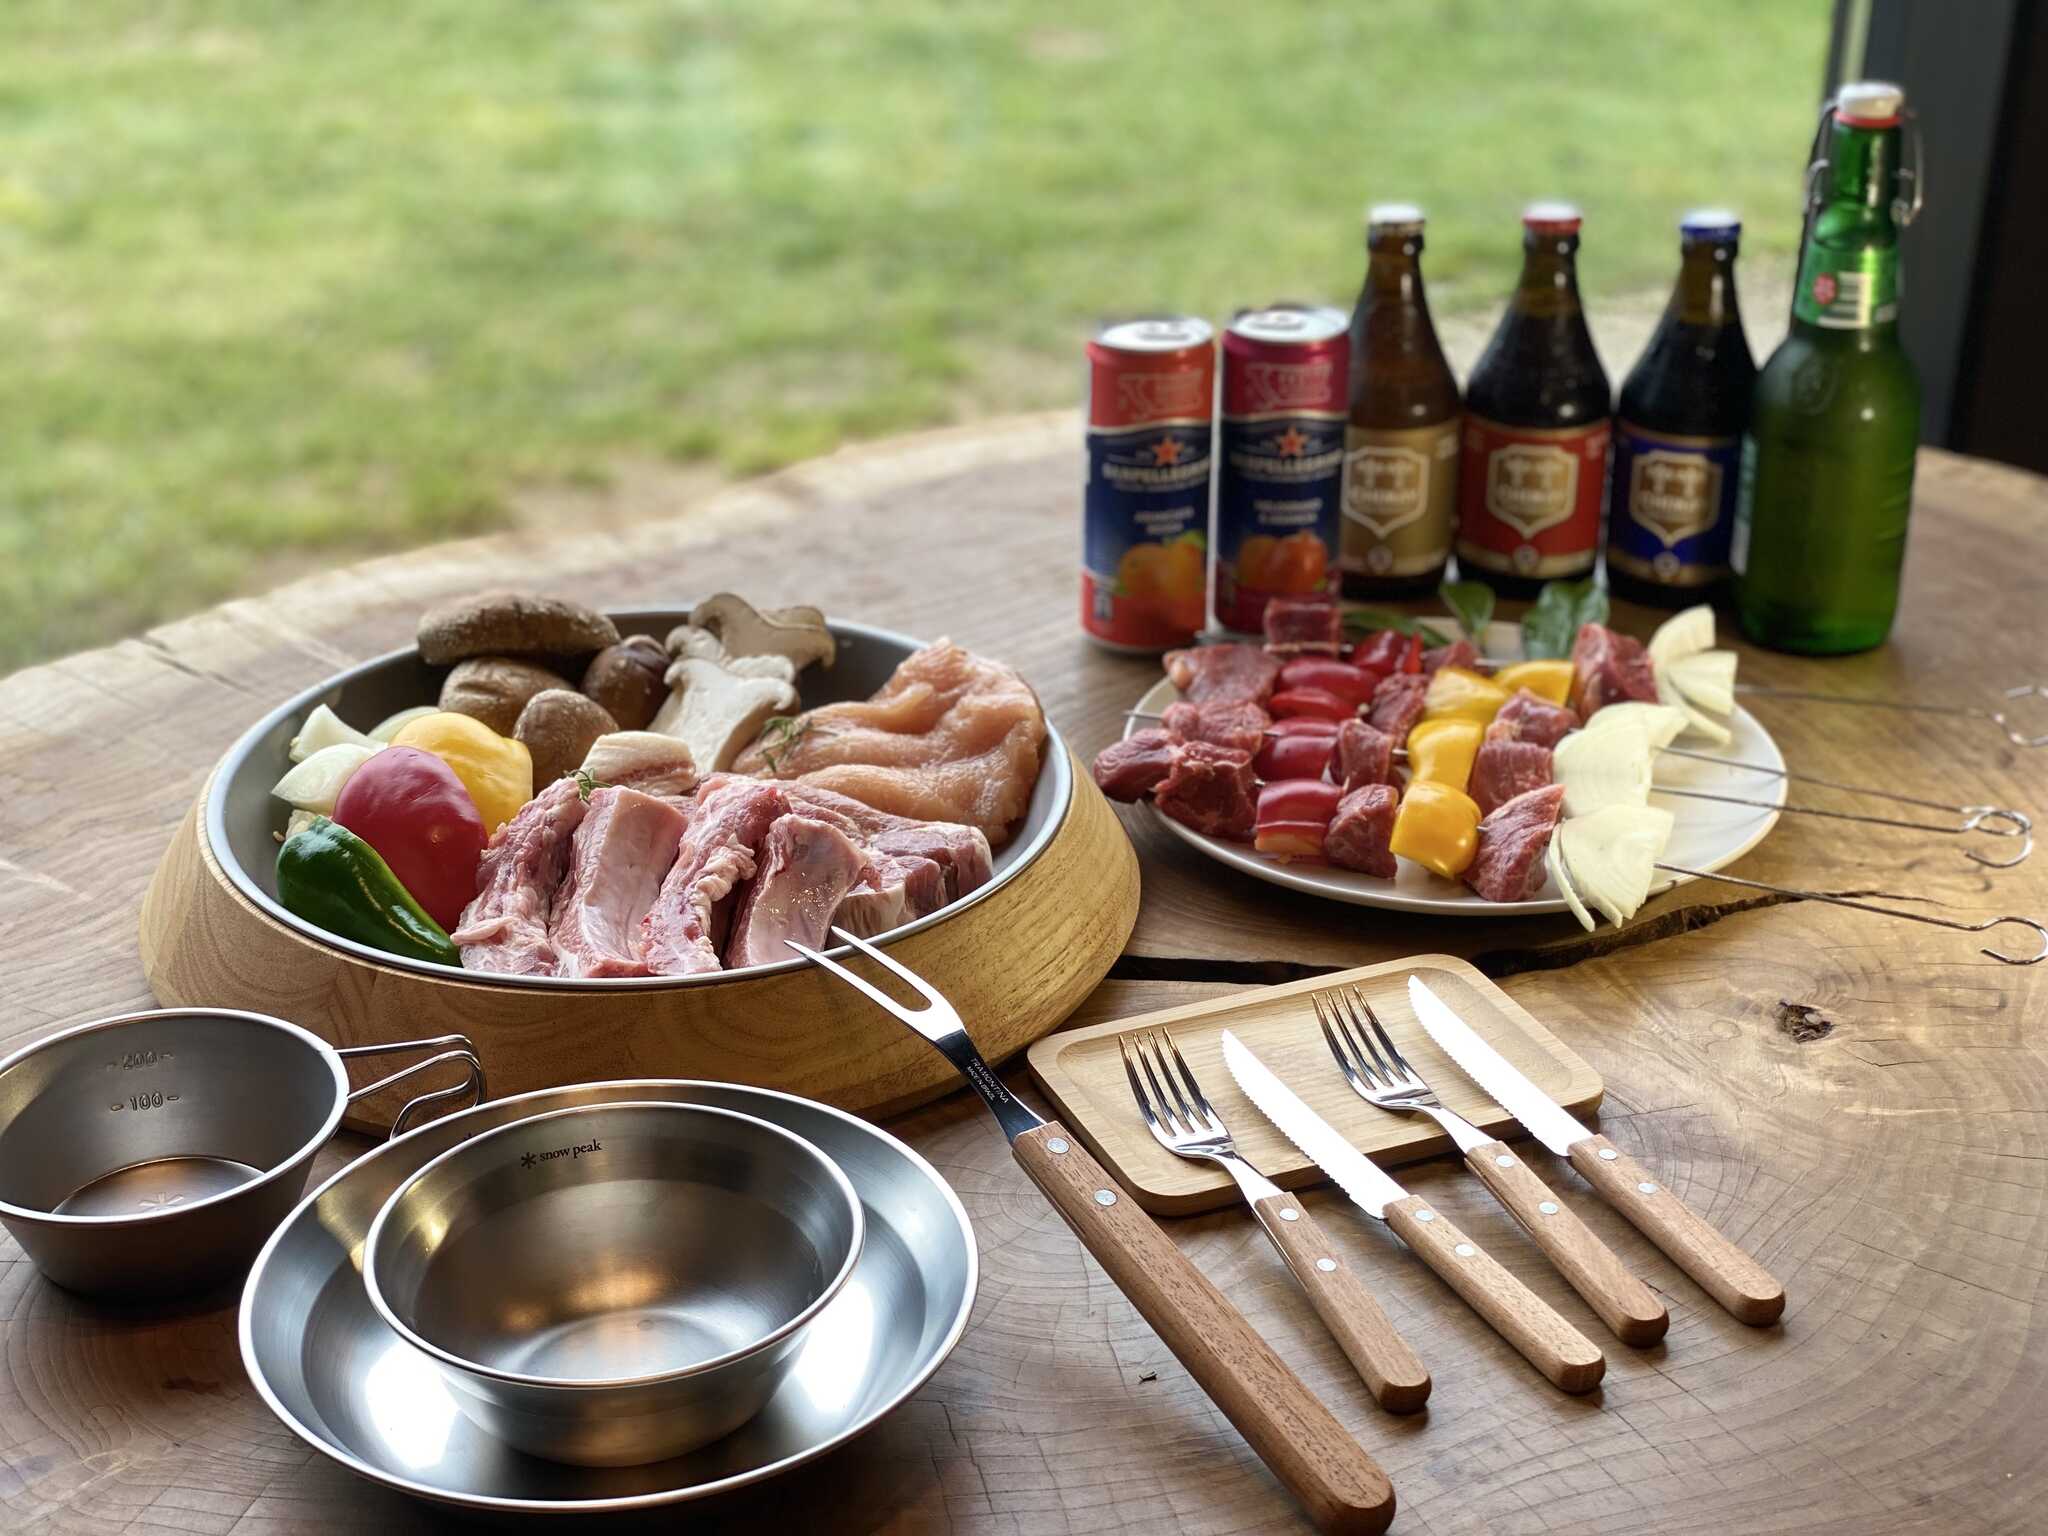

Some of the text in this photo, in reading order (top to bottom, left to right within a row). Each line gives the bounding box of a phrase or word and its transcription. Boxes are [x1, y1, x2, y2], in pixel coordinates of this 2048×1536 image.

[970, 1057, 1009, 1103] TRAMONTINA
[540, 1138, 602, 1161] snow peak
